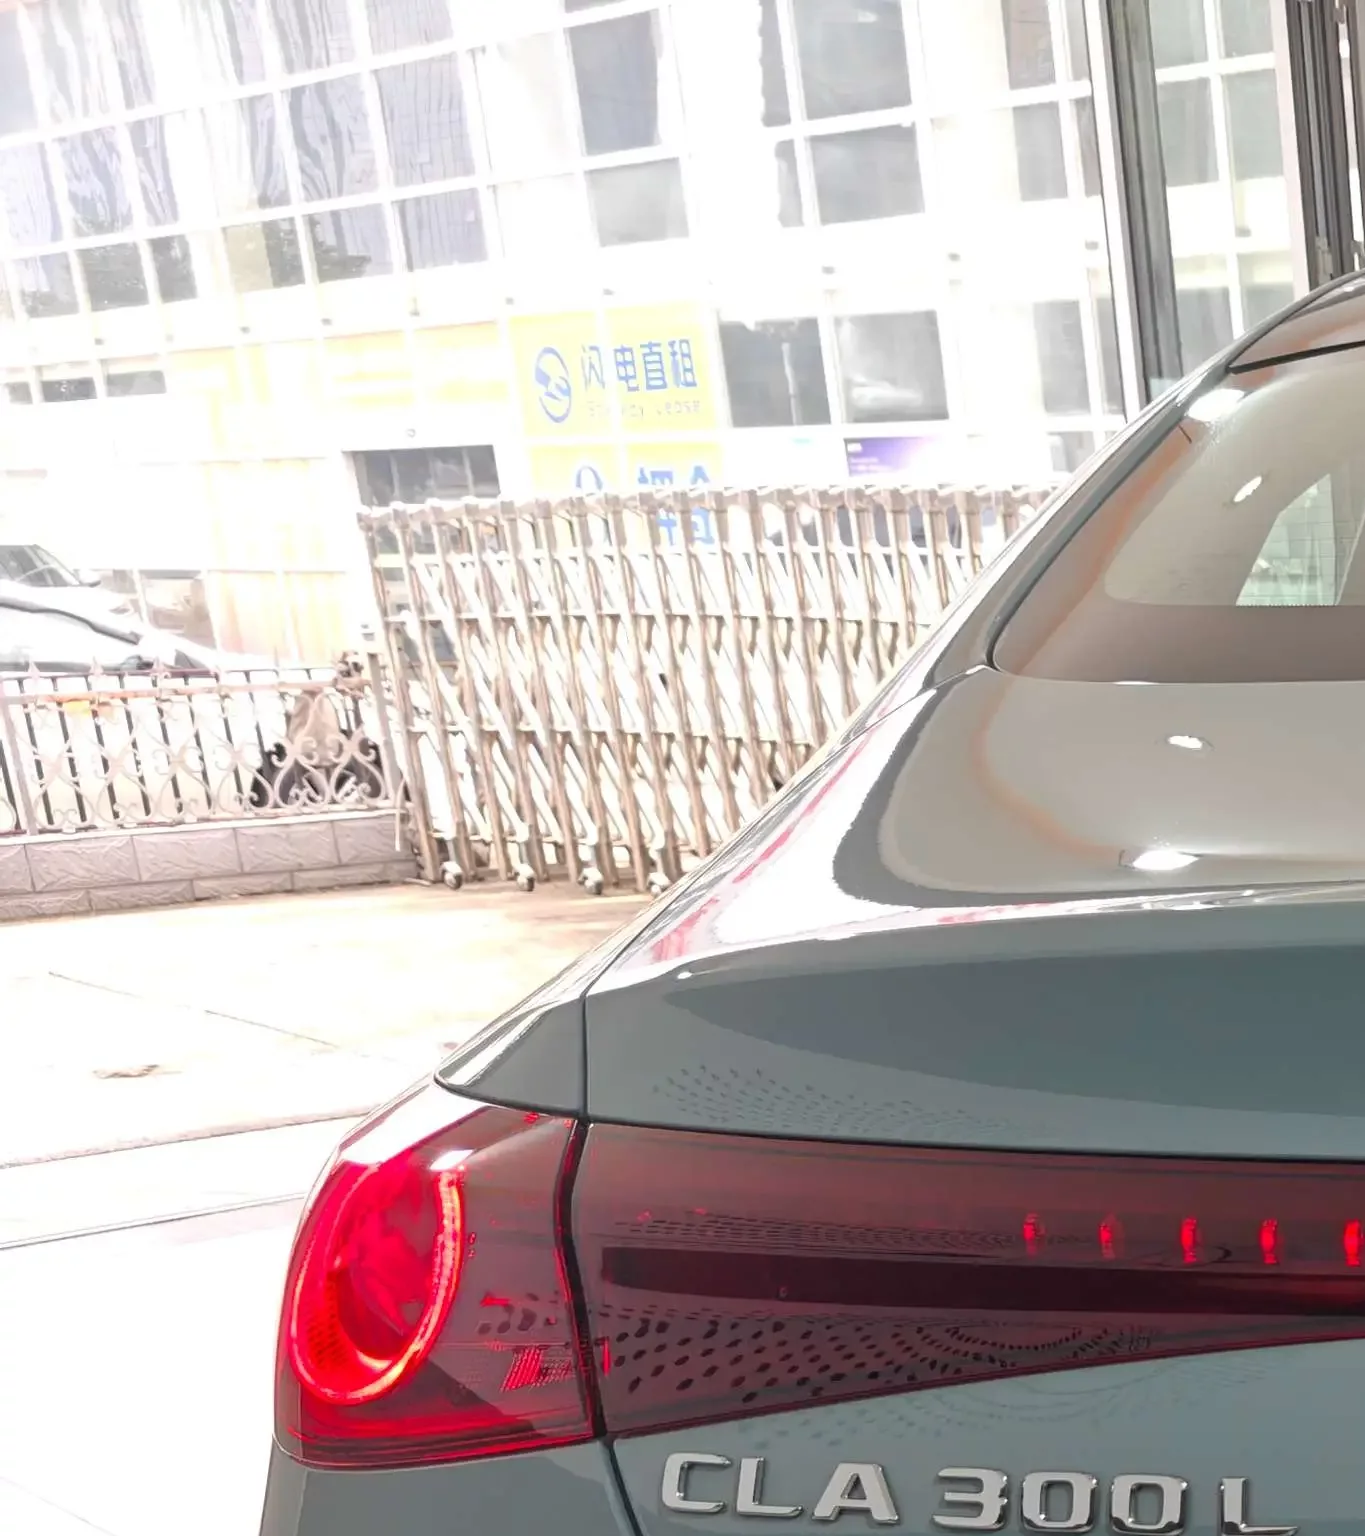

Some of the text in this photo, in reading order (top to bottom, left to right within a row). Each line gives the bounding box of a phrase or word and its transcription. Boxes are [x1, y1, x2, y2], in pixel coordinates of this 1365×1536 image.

[580, 338, 698, 392] 闪电直租
[661, 1452, 900, 1525] CLA
